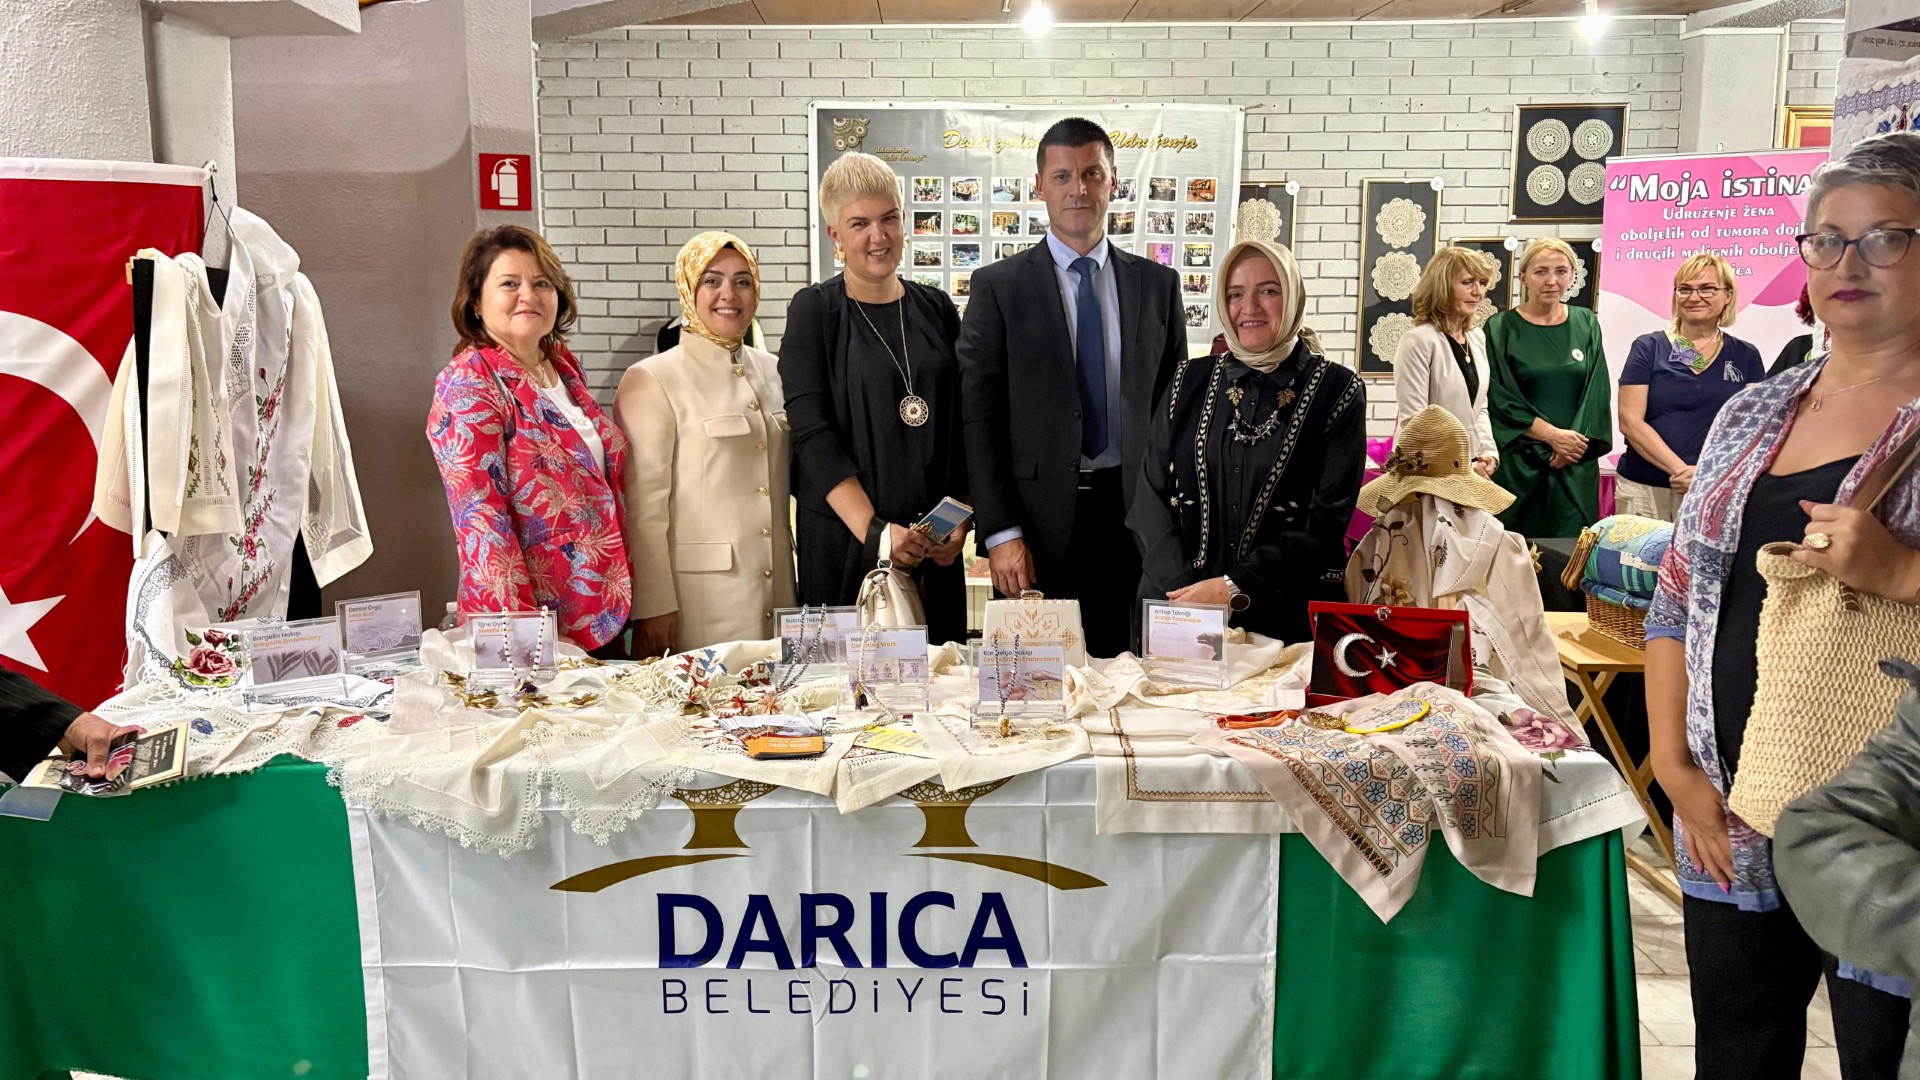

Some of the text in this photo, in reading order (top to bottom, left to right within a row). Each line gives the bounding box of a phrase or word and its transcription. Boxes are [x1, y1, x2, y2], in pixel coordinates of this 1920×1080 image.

[1662, 204, 1775, 220] Udruženje žena
[1620, 226, 1685, 243] oboljelih
[1691, 224, 1710, 239] od
[1715, 227, 1769, 238] tumora
[1615, 247, 1621, 260] i
[1626, 245, 1676, 262] drugih
[656, 890, 1029, 971] DARICA
